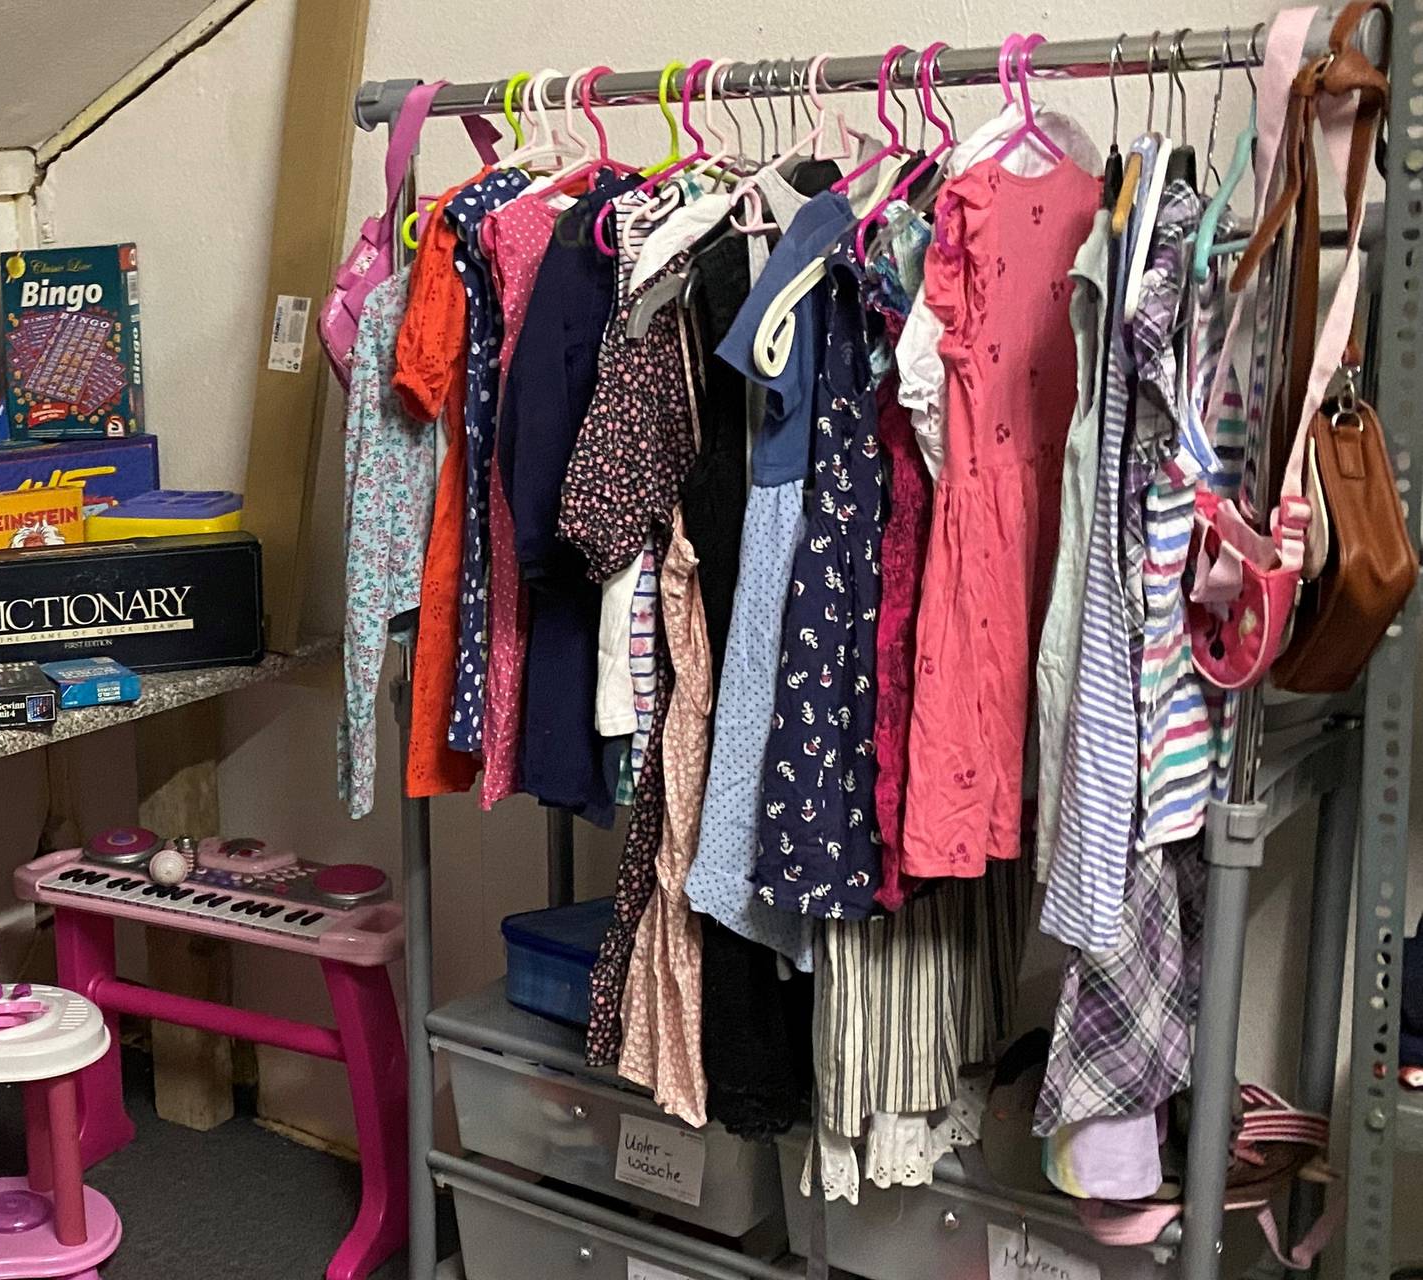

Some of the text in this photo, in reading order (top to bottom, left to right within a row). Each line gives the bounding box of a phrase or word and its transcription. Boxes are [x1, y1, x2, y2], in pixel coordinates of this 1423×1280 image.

[21, 279, 103, 312] Bingo
[59, 312, 111, 329] BINGO
[131, 327, 142, 386] Bingo
[0, 636, 20, 644] THE
[31, 632, 63, 641] GAME
[72, 629, 88, 638] OF
[96, 626, 135, 636] QUICK
[64, 638, 113, 650] FIRST EDITION
